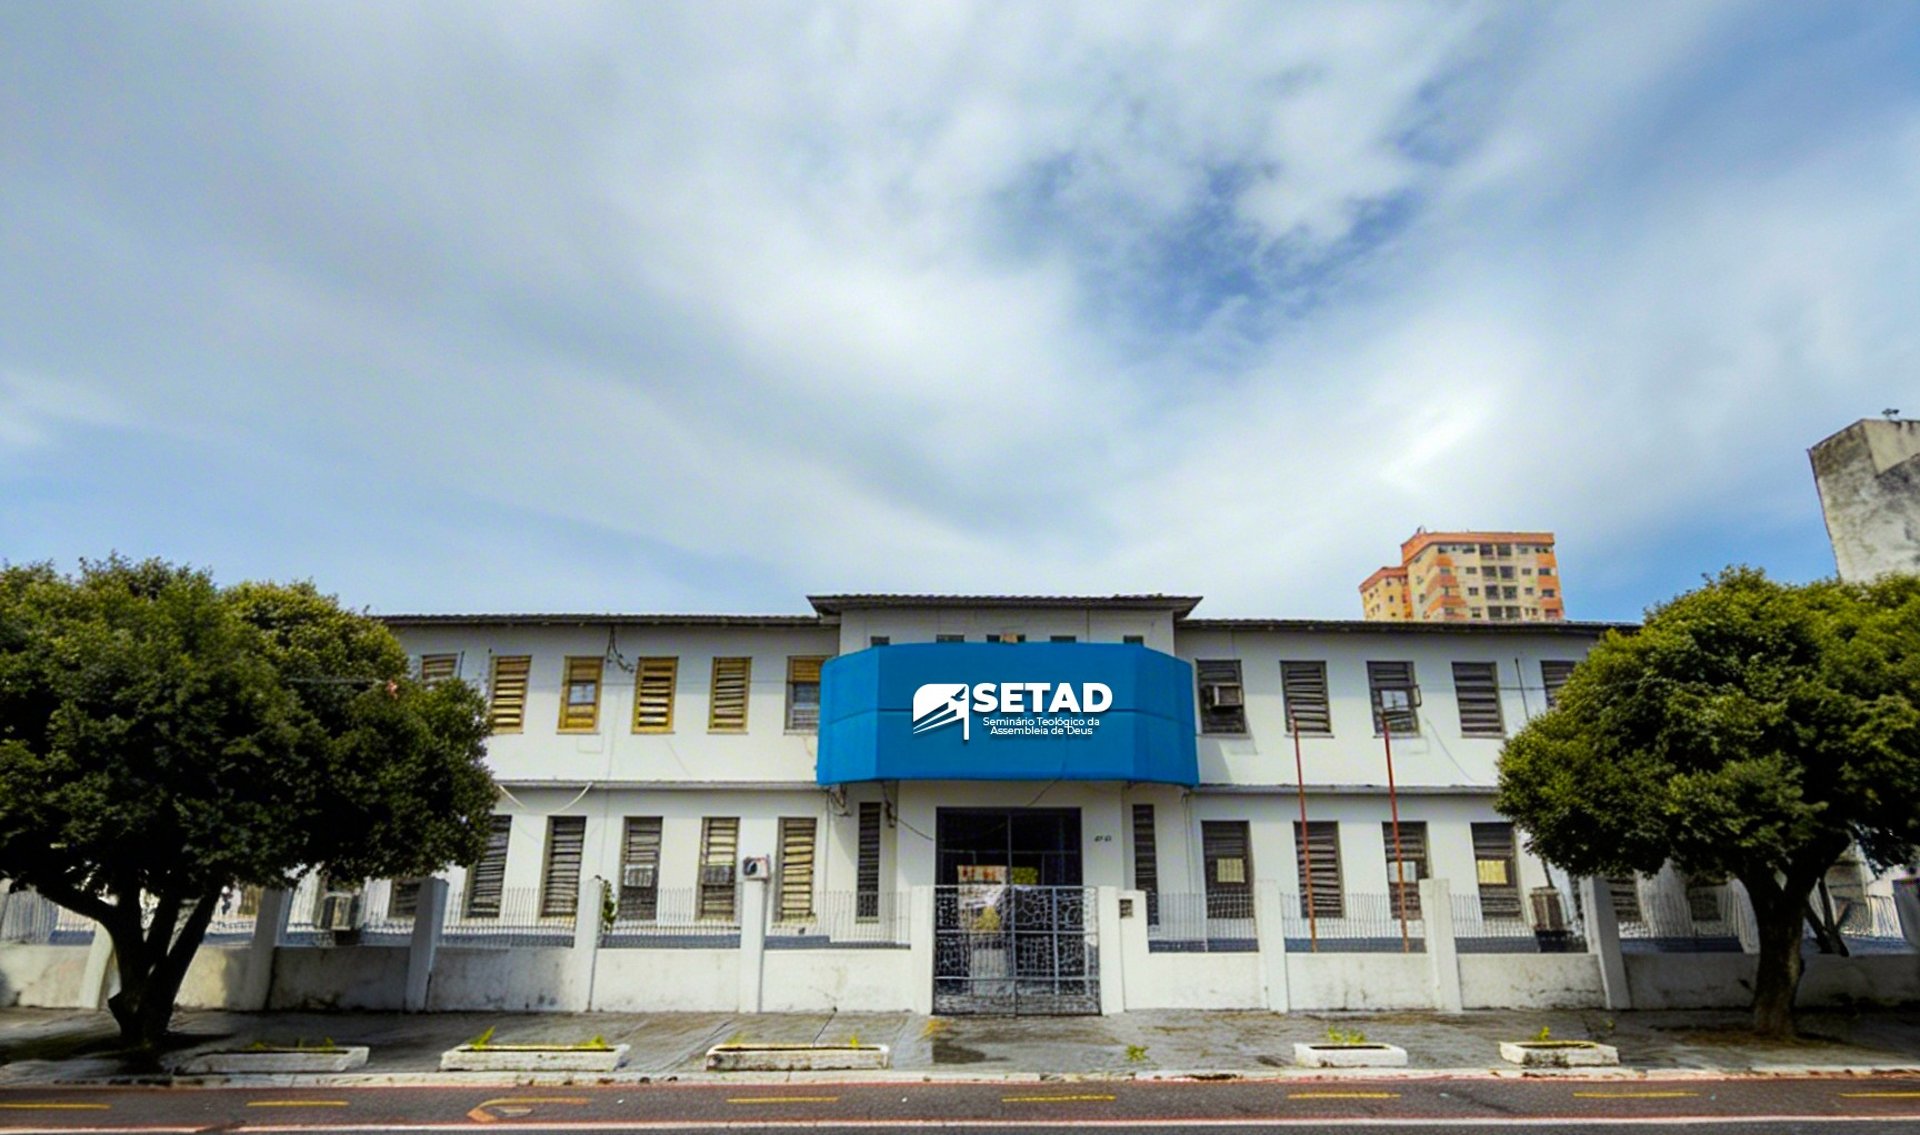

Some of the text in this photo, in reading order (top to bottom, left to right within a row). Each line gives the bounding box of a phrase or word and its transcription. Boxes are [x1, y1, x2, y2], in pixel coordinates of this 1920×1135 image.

[972, 682, 1113, 713] SETAD
[983, 717, 1100, 729] Seminário Teológico da
[990, 726, 1093, 735] Assembleia de Deus
